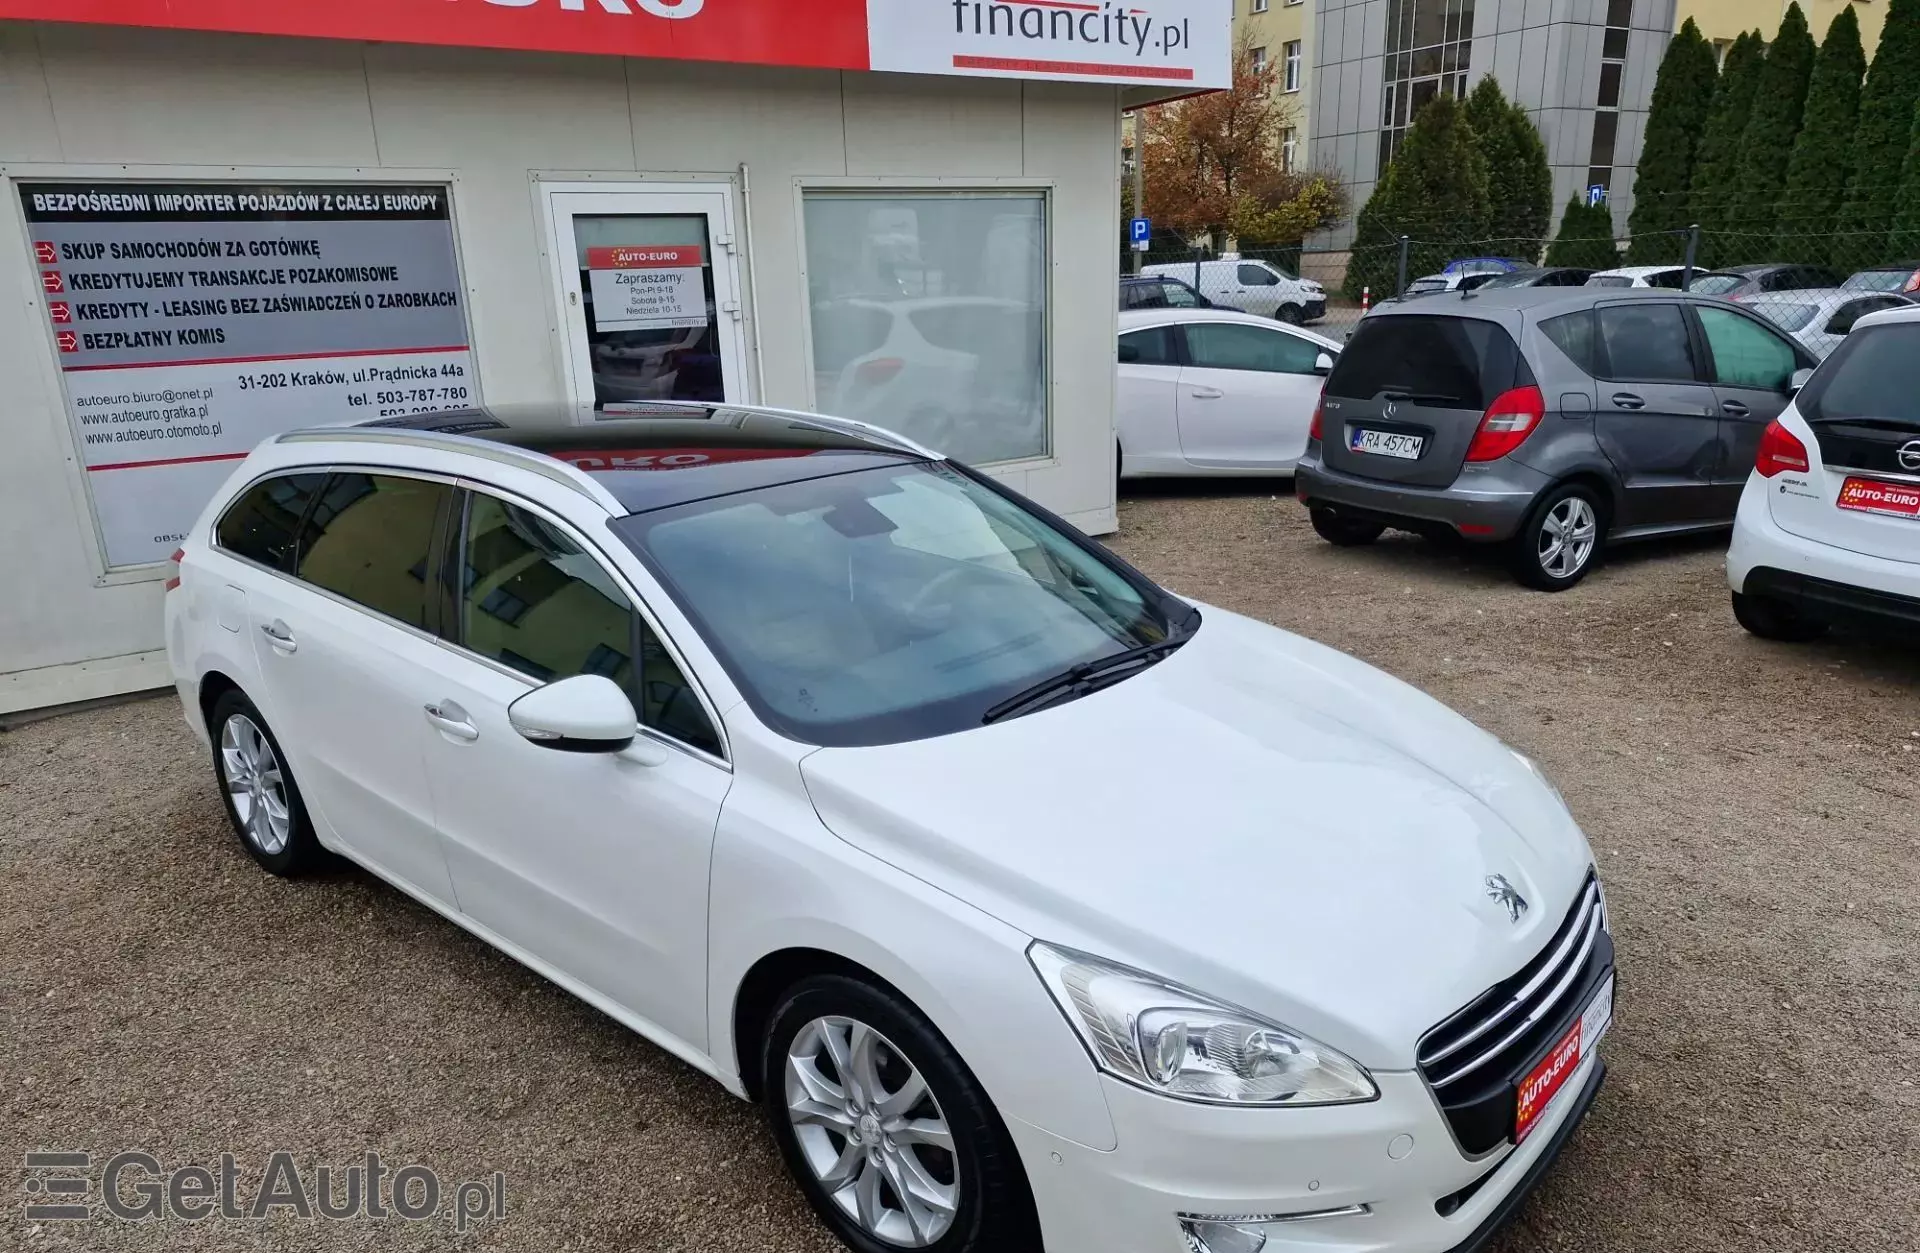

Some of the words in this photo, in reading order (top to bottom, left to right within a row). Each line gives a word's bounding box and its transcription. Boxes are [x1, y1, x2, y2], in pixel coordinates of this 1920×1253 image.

[33, 190, 150, 212] BEZPOŚREDNI
[154, 194, 236, 212] IMPORTER
[238, 191, 319, 211] POJAZDÓW
[323, 195, 333, 211] Z
[336, 195, 379, 211] CAŁEJ
[384, 195, 437, 211] EUROPY
[1135, 221, 1146, 239] P
[61, 242, 105, 260] SKUP
[110, 238, 221, 259] SAMOCHODÓW
[226, 241, 246, 257] ZA
[249, 237, 321, 259] GOTÓWKĘ
[618, 252, 678, 261] AUTO-EURO
[69, 273, 184, 291] KREDYTUJEMY
[188, 269, 286, 286] TRANSAKCJE
[289, 266, 399, 284] POZAKOMISOWE
[77, 303, 149, 320] KREDYTY
[163, 299, 228, 317] LEASING
[232, 298, 260, 314] BEZ
[262, 293, 362, 313] ZAŚWIADCZEŃ
[364, 294, 375, 309] O
[378, 292, 457, 308] ZAROBKACH
[83, 331, 172, 350] BEZPŁATNY
[178, 328, 226, 345] KOMIS
[237, 374, 288, 390] 31-202
[291, 371, 349, 387] Kraków,
[353, 365, 438, 385] ul.Prądnicka
[440, 364, 464, 377] 44a
[77, 387, 214, 407] autoeuro.biuro@onet.pl
[347, 393, 372, 407] tel.
[377, 386, 468, 405] 503-787-780
[80, 404, 209, 425] www.autoeuro.gratka.pl
[85, 421, 222, 444] www.autoeuro.otomoto.pl
[1359, 430, 1381, 449] KRA
[1383, 435, 1420, 455] 457CM
[1848, 488, 1919, 506] AUTO-EURO
[1521, 1034, 1579, 1113] AUTO-EURO
